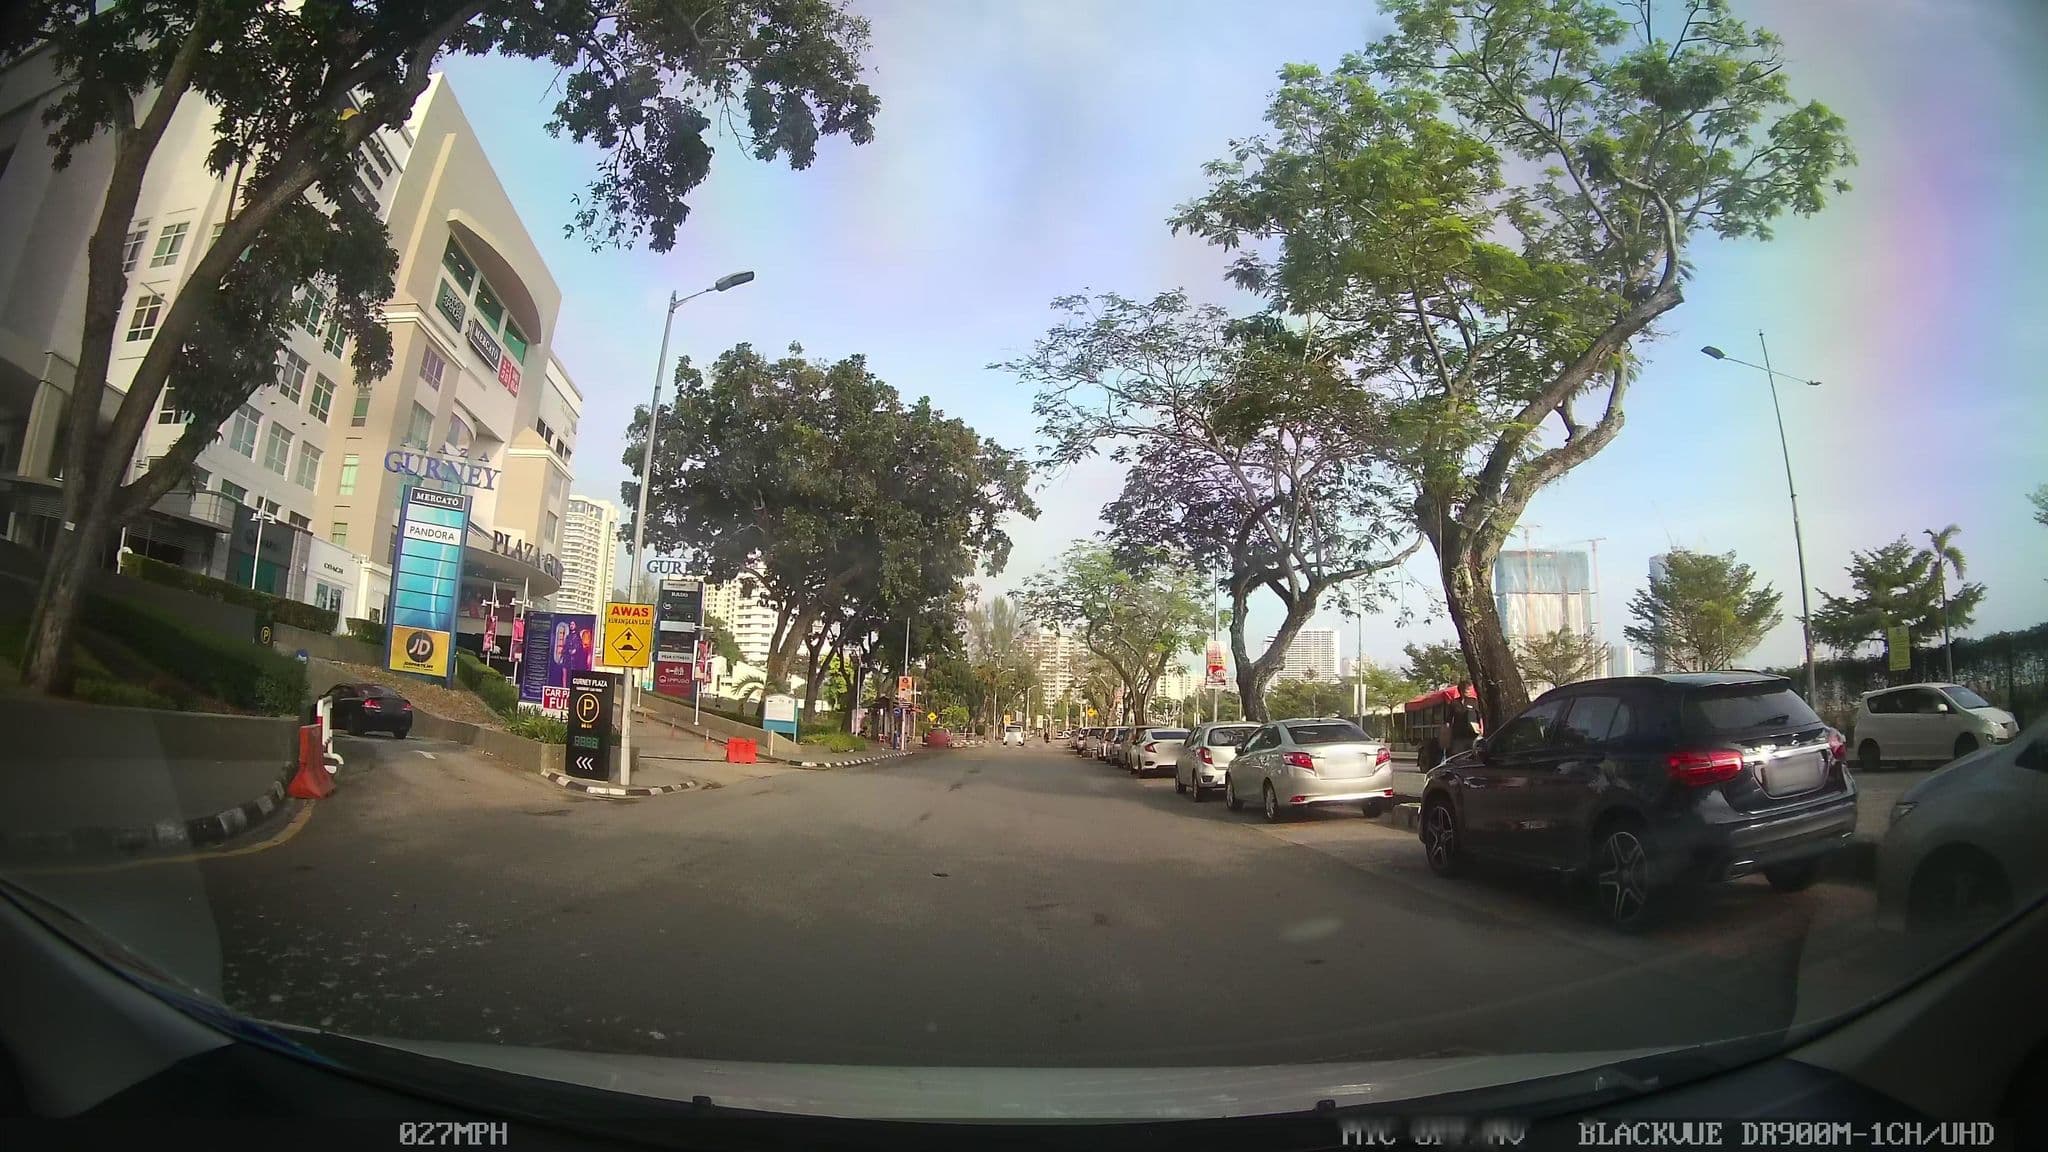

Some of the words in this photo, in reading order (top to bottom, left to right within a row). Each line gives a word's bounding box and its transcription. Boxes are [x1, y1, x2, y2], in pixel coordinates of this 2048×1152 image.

[384, 450, 502, 491] GURNEY
[409, 525, 455, 541] PANDORA
[611, 606, 649, 617] AWAS
[409, 638, 431, 656] JD
[572, 677, 591, 686] GURNEY
[592, 679, 608, 688] PLAZA
[545, 688, 561, 698] CAR
